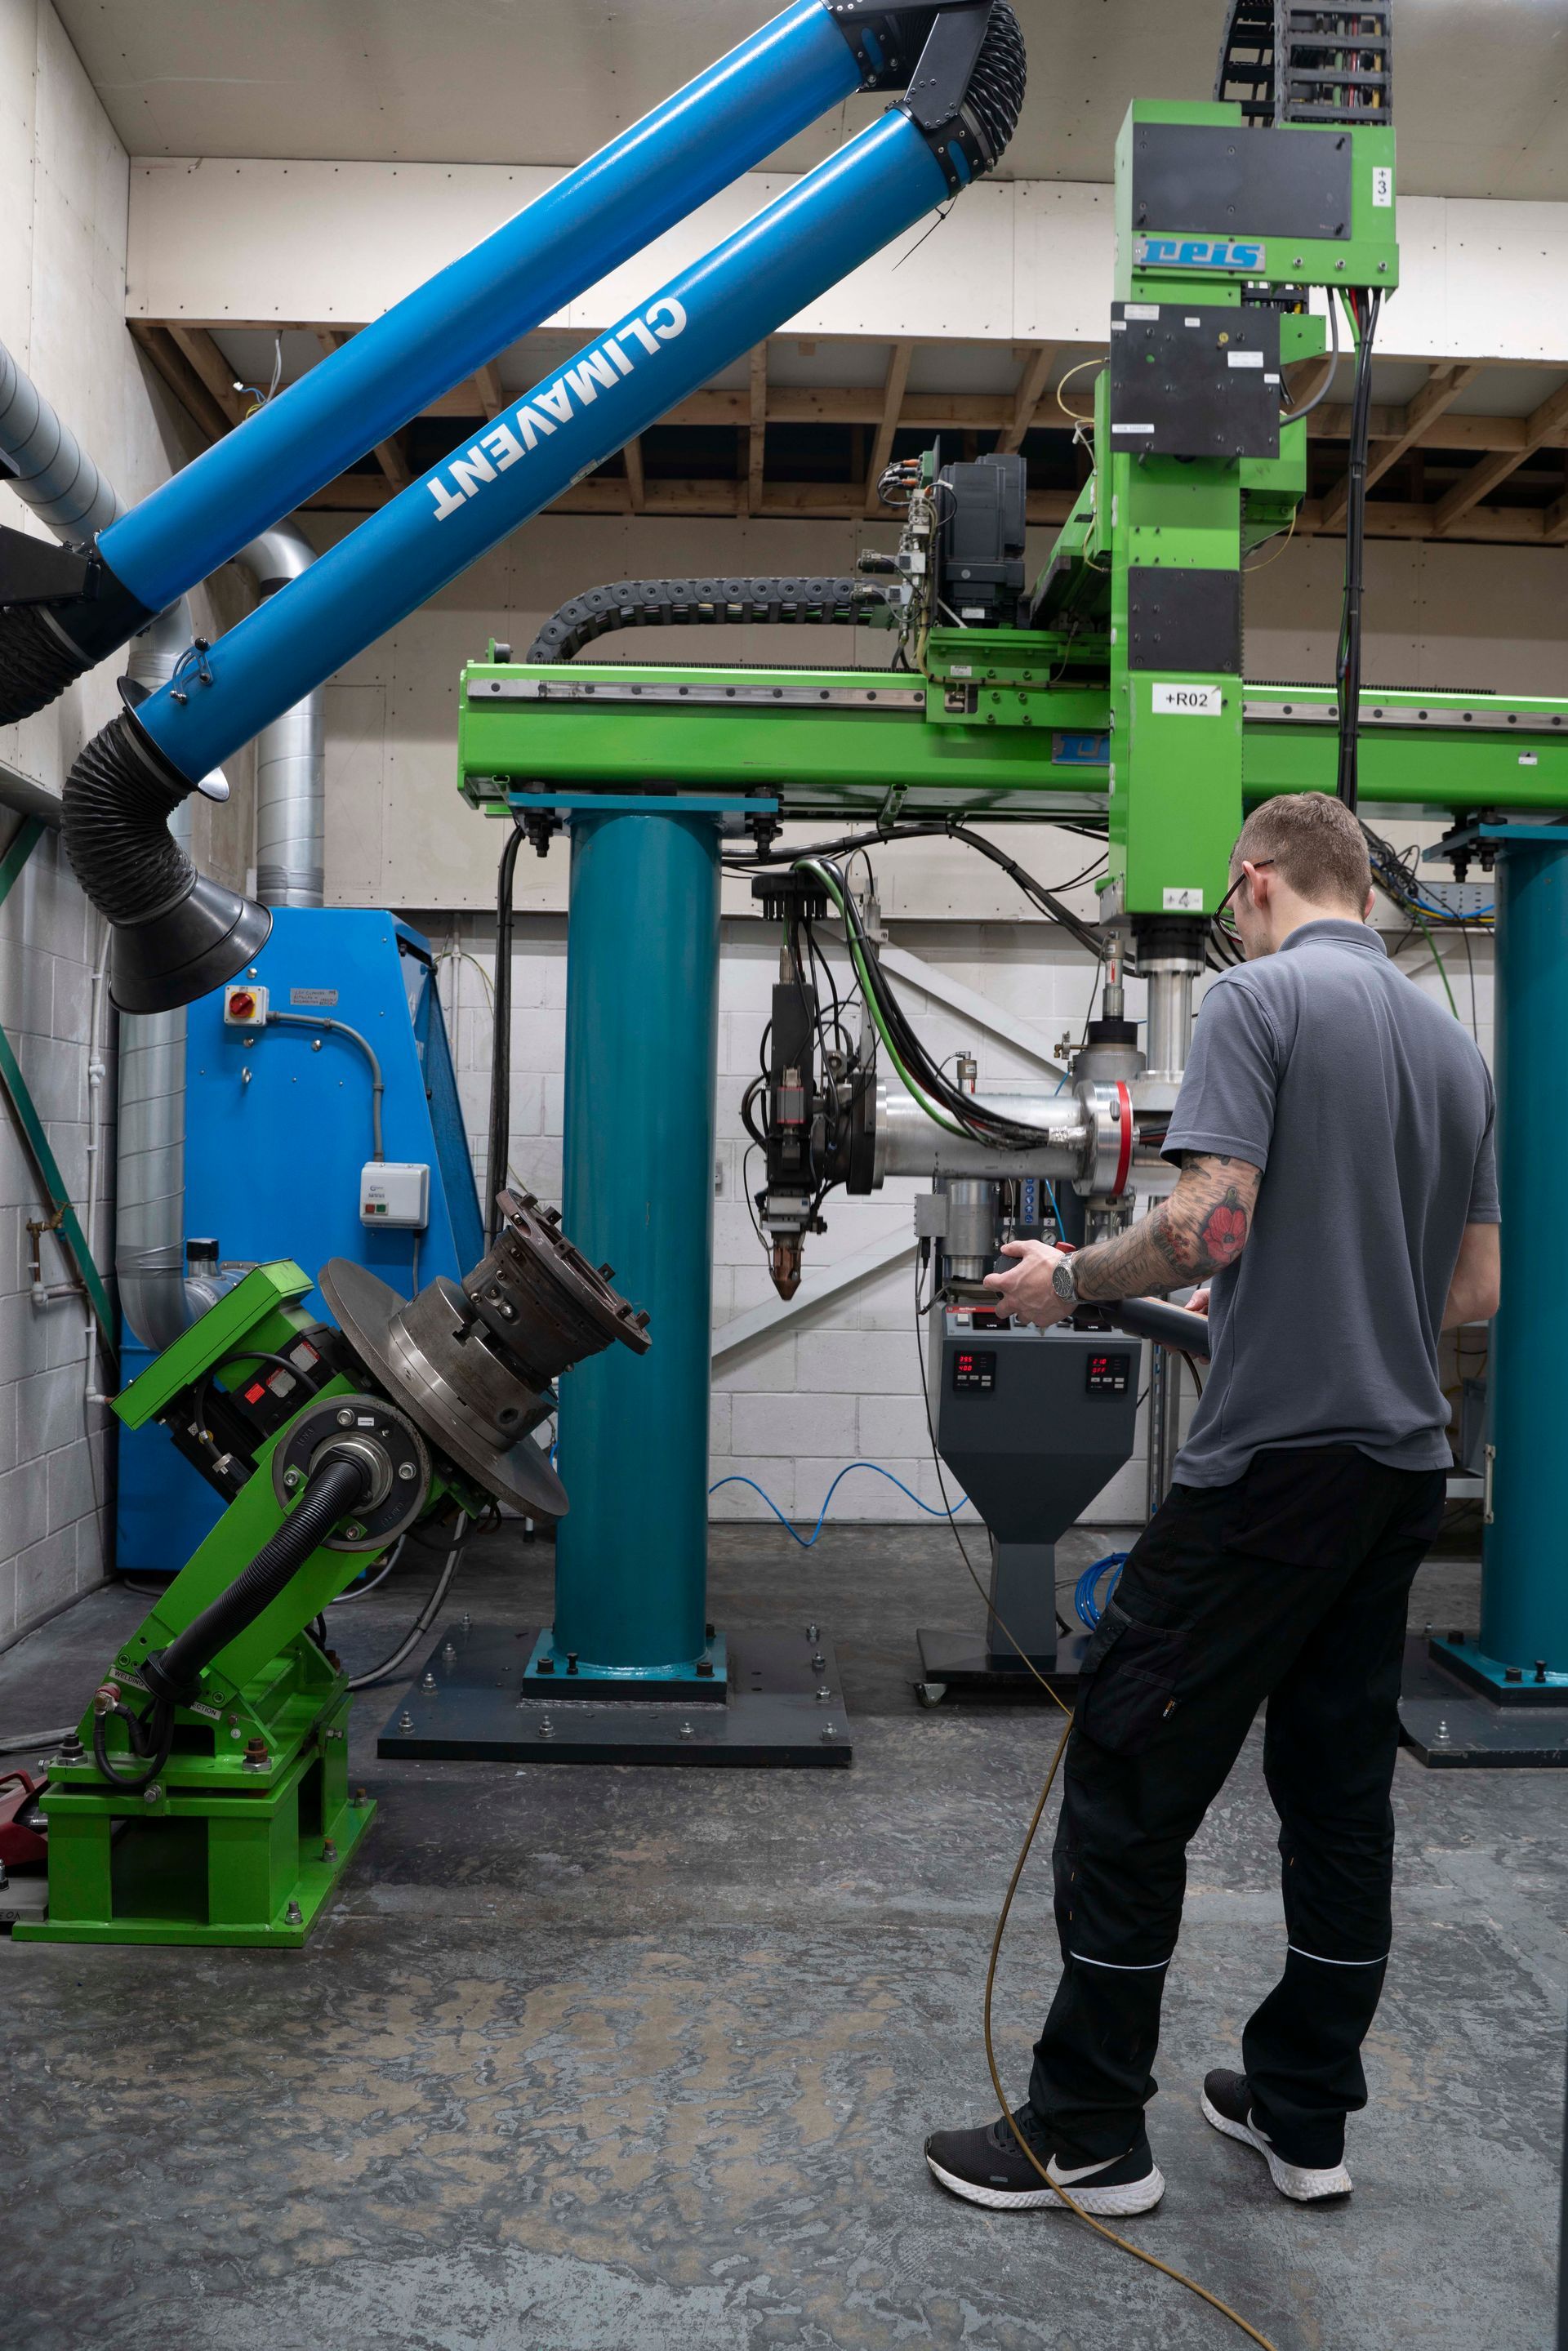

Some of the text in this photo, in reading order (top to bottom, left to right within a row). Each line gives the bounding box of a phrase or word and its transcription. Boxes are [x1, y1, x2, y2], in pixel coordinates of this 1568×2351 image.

[1378, 180, 1387, 194] 3
[426, 297, 687, 521] CLIMAVENT
[1165, 692, 1208, 707] +R02
[1178, 891, 1189, 908] 4
[114, 1670, 217, 1716] WELDING ECTION
